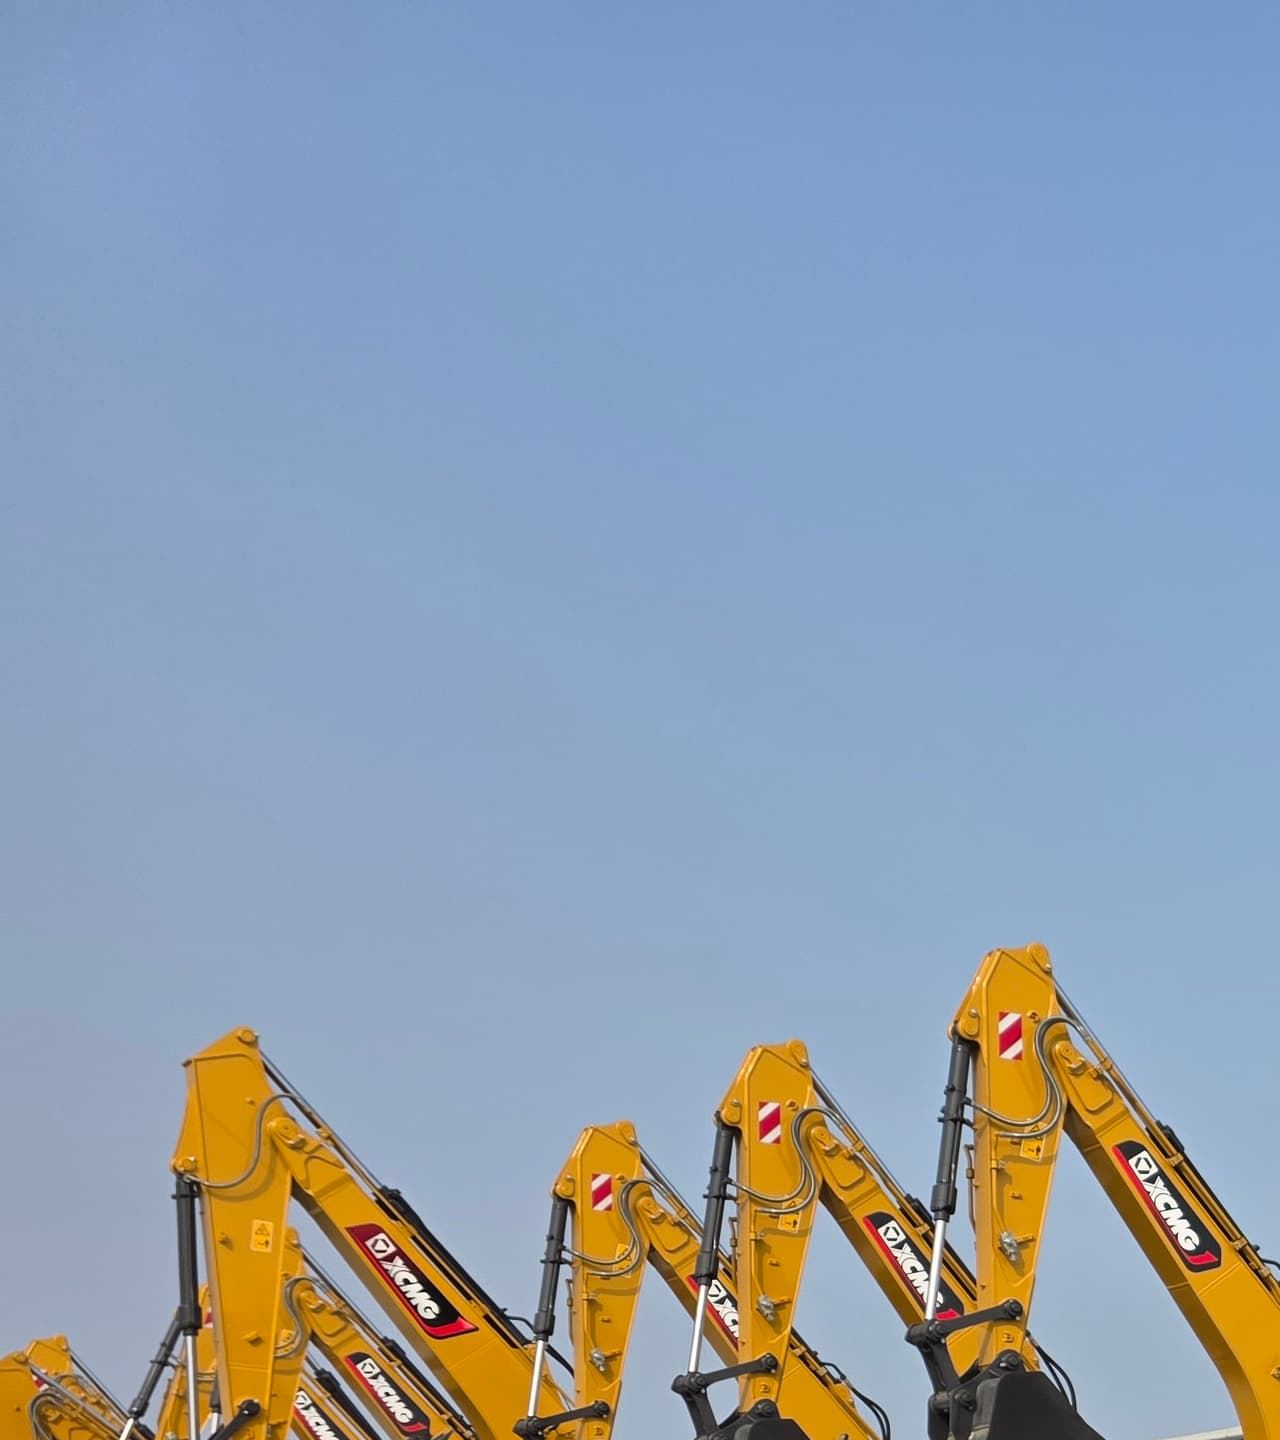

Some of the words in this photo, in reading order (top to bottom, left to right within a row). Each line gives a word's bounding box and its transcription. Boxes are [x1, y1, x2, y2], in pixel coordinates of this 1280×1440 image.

[1143, 1175, 1200, 1251] XCMG
[379, 1255, 440, 1320] XCMG
[713, 1298, 739, 1338] XC
[367, 1374, 414, 1423] XCMG
